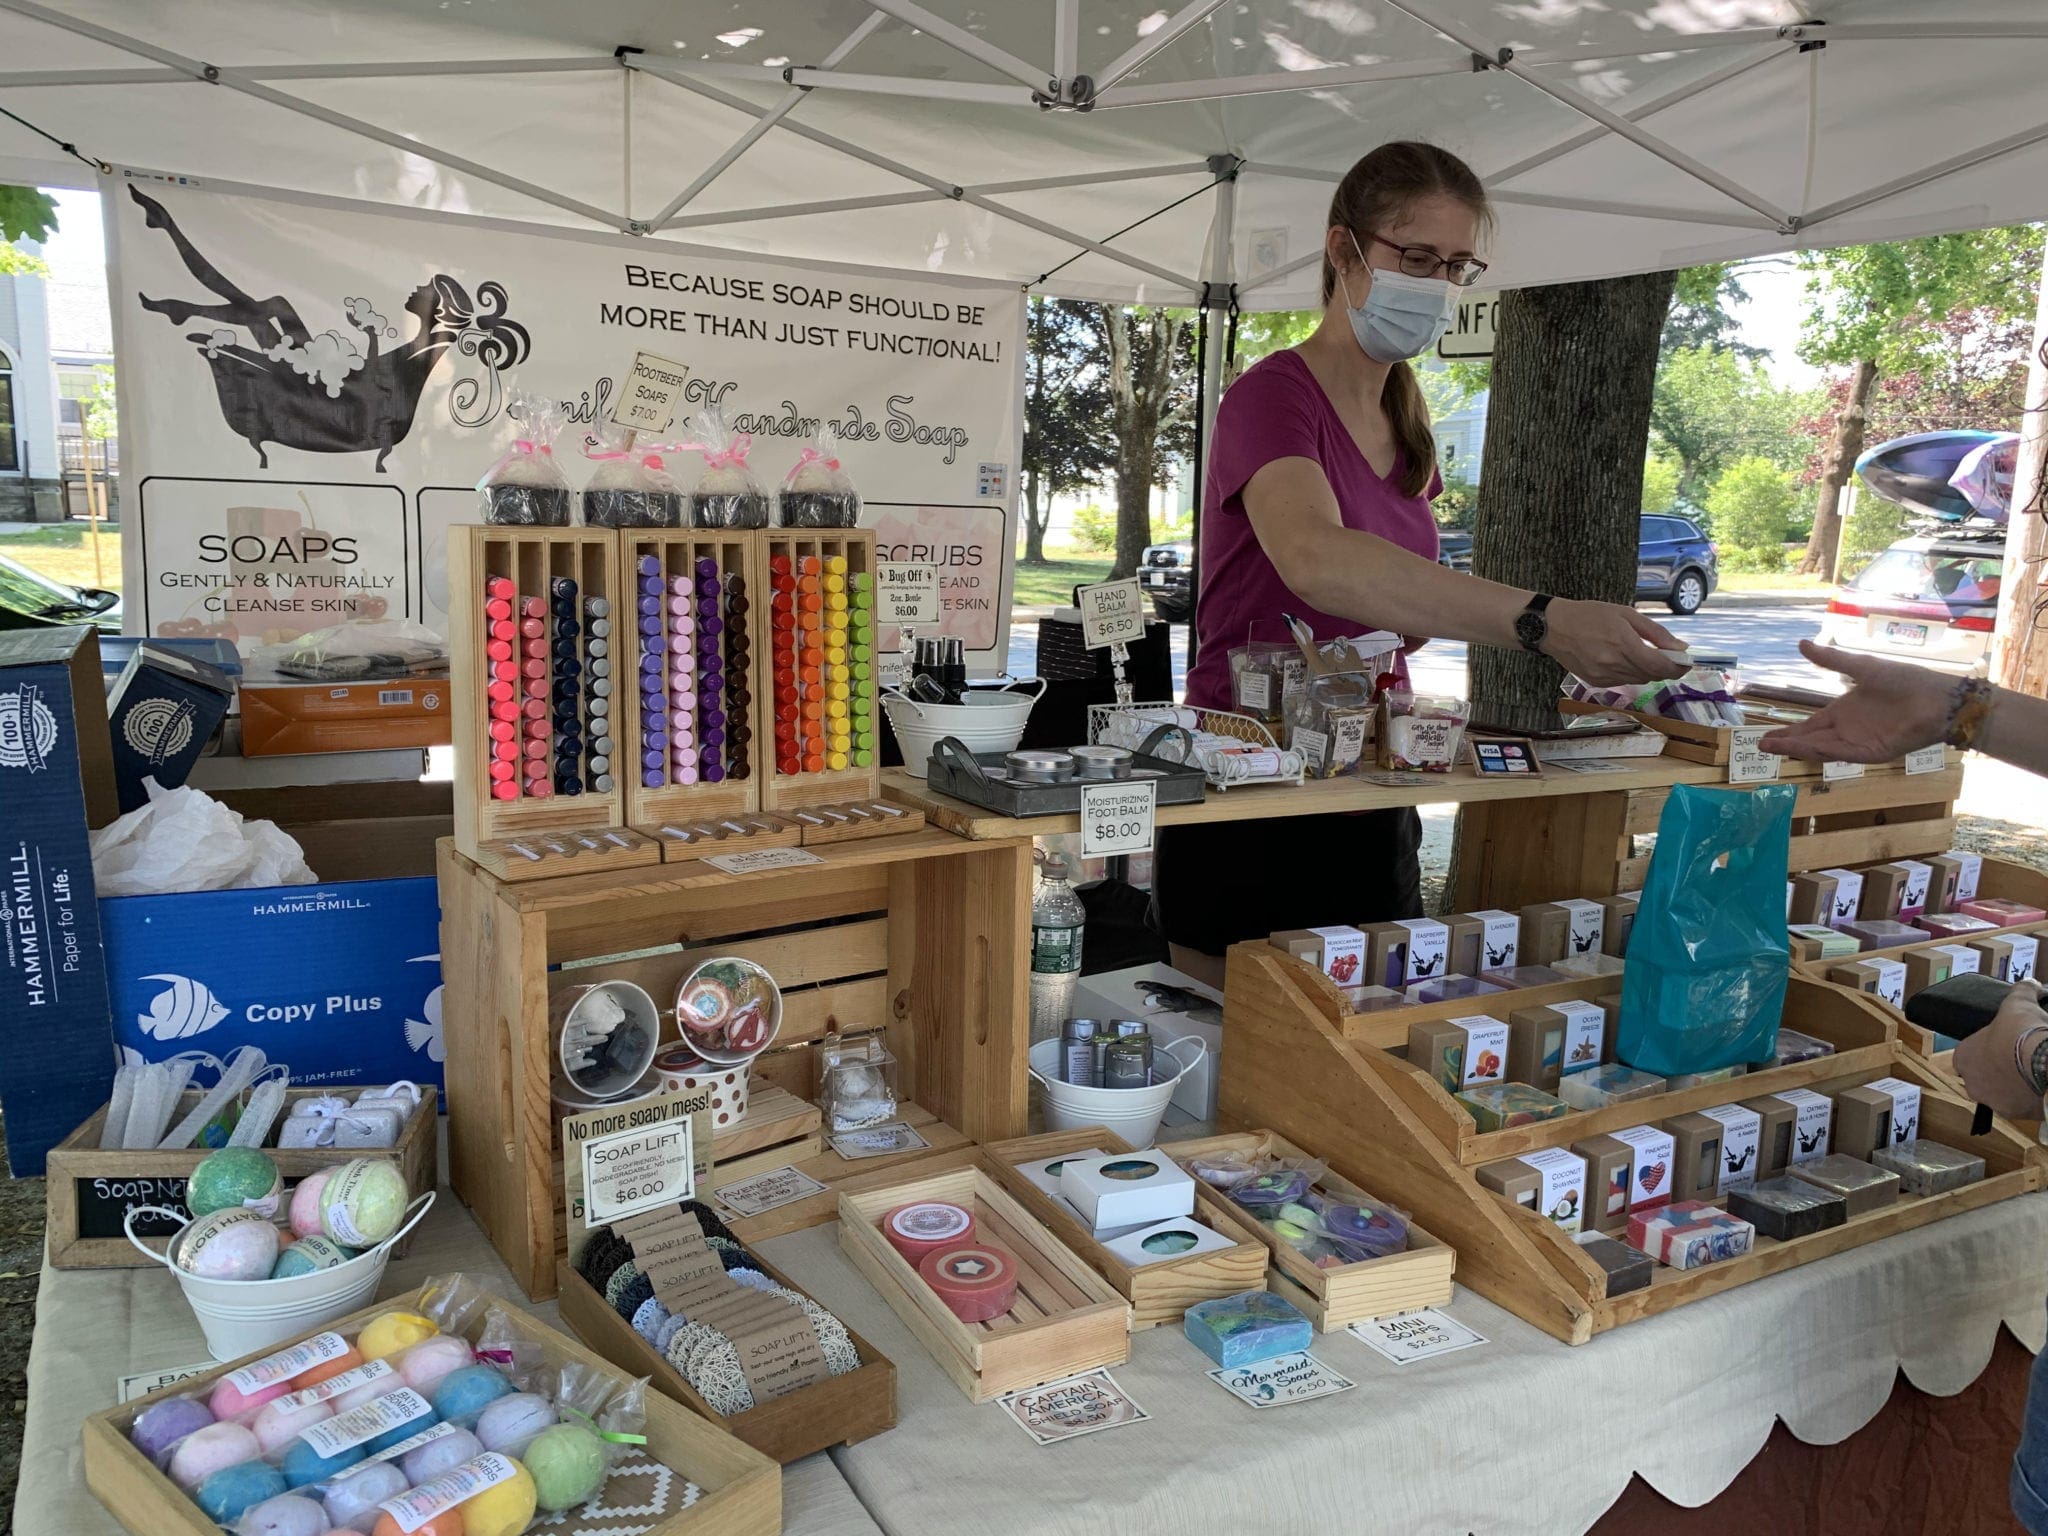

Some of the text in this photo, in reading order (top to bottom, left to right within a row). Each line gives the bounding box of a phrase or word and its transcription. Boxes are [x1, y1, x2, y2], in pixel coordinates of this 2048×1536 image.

[625, 264, 985, 326] BECAUSE SOAP SHOULD BE
[601, 303, 1001, 363] MORE THAN JUST FUNCTIONAL!
[633, 363, 684, 387] ROOTBEER
[635, 385, 668, 404] SOAPS
[630, 405, 657, 421] $7.00
[884, 395, 969, 464] Soap
[198, 535, 359, 564] SOAPS
[876, 544, 983, 567] SCRUBS
[160, 572, 395, 588] GENTLY & NATURALLY
[889, 569, 922, 584] Bug Off
[950, 577, 980, 588] AND
[204, 596, 356, 612] CLEANSE SKIN
[956, 598, 989, 610] SKIN
[1094, 589, 1127, 604] HAND
[895, 605, 918, 616] $6.00
[1098, 600, 1126, 613] BALM
[1098, 618, 1133, 636] $6.50
[3, 713, 18, 745] 100+
[22, 690, 39, 766] HAMMERMILL
[147, 713, 165, 739] 100+
[155, 703, 188, 760] HAMMERMILL
[1734, 735, 1760, 747] SAMP
[1734, 751, 1756, 763] GIFT
[1087, 795, 1150, 807] MOISTURIZING
[1088, 806, 1148, 818] FOOT BALM
[1096, 822, 1141, 841] $8.00
[253, 899, 366, 915] HAMMERMILL
[11, 847, 45, 1006] HAMMERMILL
[53, 869, 83, 972] Paper for Life.
[1490, 922, 1516, 931] LAVENDER
[1415, 931, 1446, 939] RASPBERRY
[246, 995, 382, 1023] Copy Plus
[1582, 1016, 1601, 1024] OCEAN
[1472, 1030, 1505, 1040] GRAPEFRUIT
[569, 1091, 709, 1141] No more soapy mess!
[594, 1132, 680, 1165] SOAP LIFT
[1552, 1167, 1582, 1181] COCONUT
[94, 1178, 153, 1202] Soap
[616, 1180, 664, 1204] $6.00
[723, 1171, 798, 1200] AVENGERS
[1552, 1177, 1582, 1191] SHAVINGS
[646, 1233, 698, 1256] SOAP LIFT
[662, 1265, 714, 1289] SOAP LIFT
[1379, 1318, 1426, 1334] MINI
[1386, 1324, 1441, 1341] SOAPS
[750, 1331, 805, 1358] SOAP LIFT
[753, 1376, 766, 1384] Eco
[1231, 1358, 1312, 1388] Mermaid
[1276, 1368, 1320, 1387] Soaps
[399, 1391, 421, 1411] BATH
[1019, 1381, 1098, 1408] CAPTAIN
[1028, 1390, 1109, 1416] AMERICA
[384, 1393, 414, 1419] BOMBS
[1028, 1397, 1123, 1426] SHIELD SOAP
